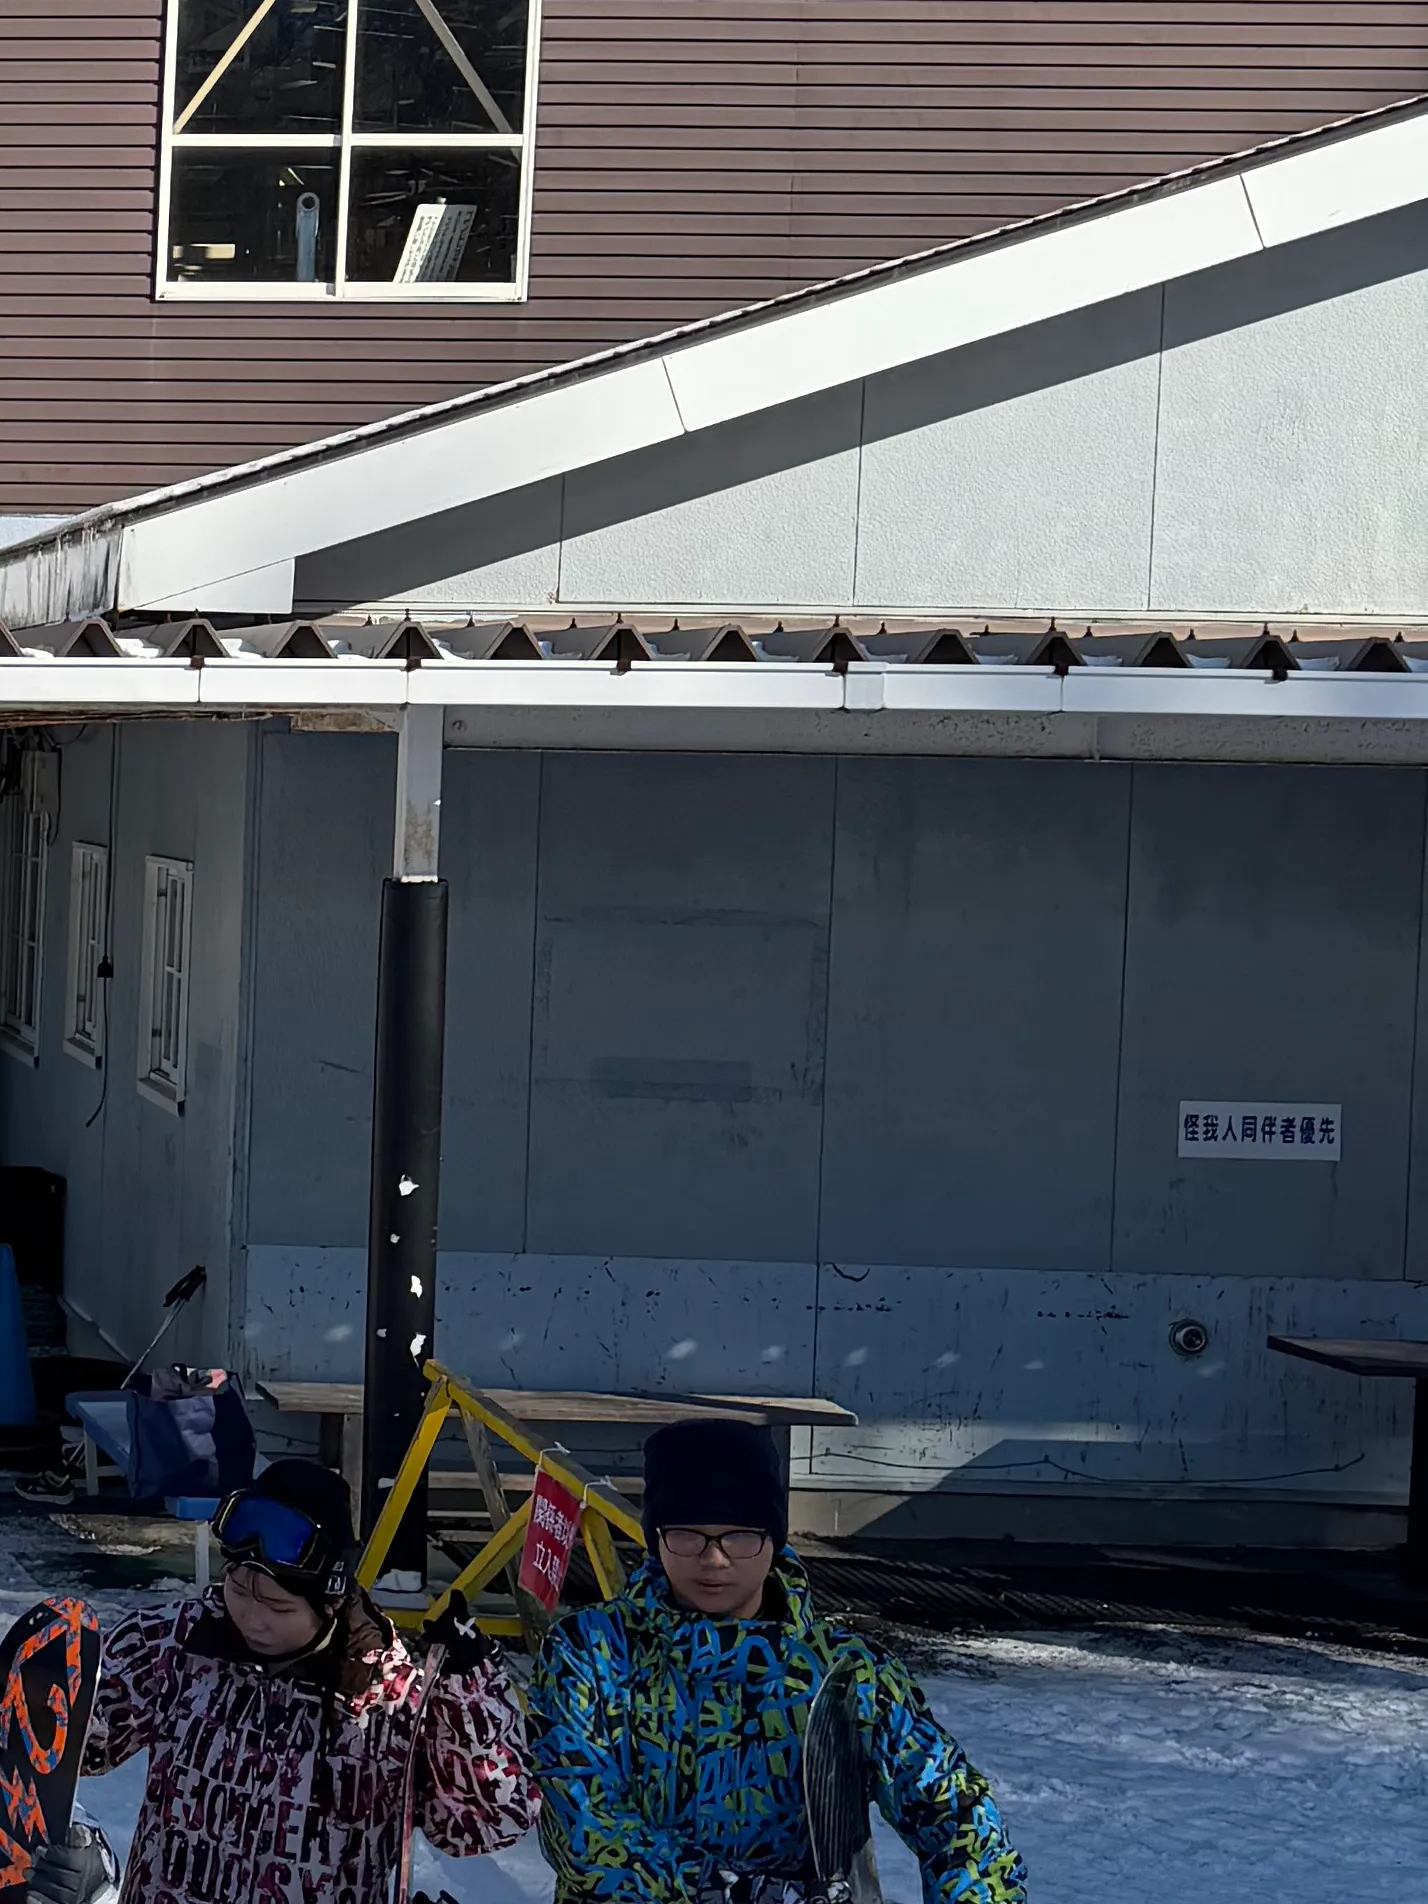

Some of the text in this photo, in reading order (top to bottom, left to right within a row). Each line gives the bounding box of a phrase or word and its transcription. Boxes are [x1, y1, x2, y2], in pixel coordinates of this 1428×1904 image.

[1183, 1113, 1335, 1144] 怪我人同伴者優先
